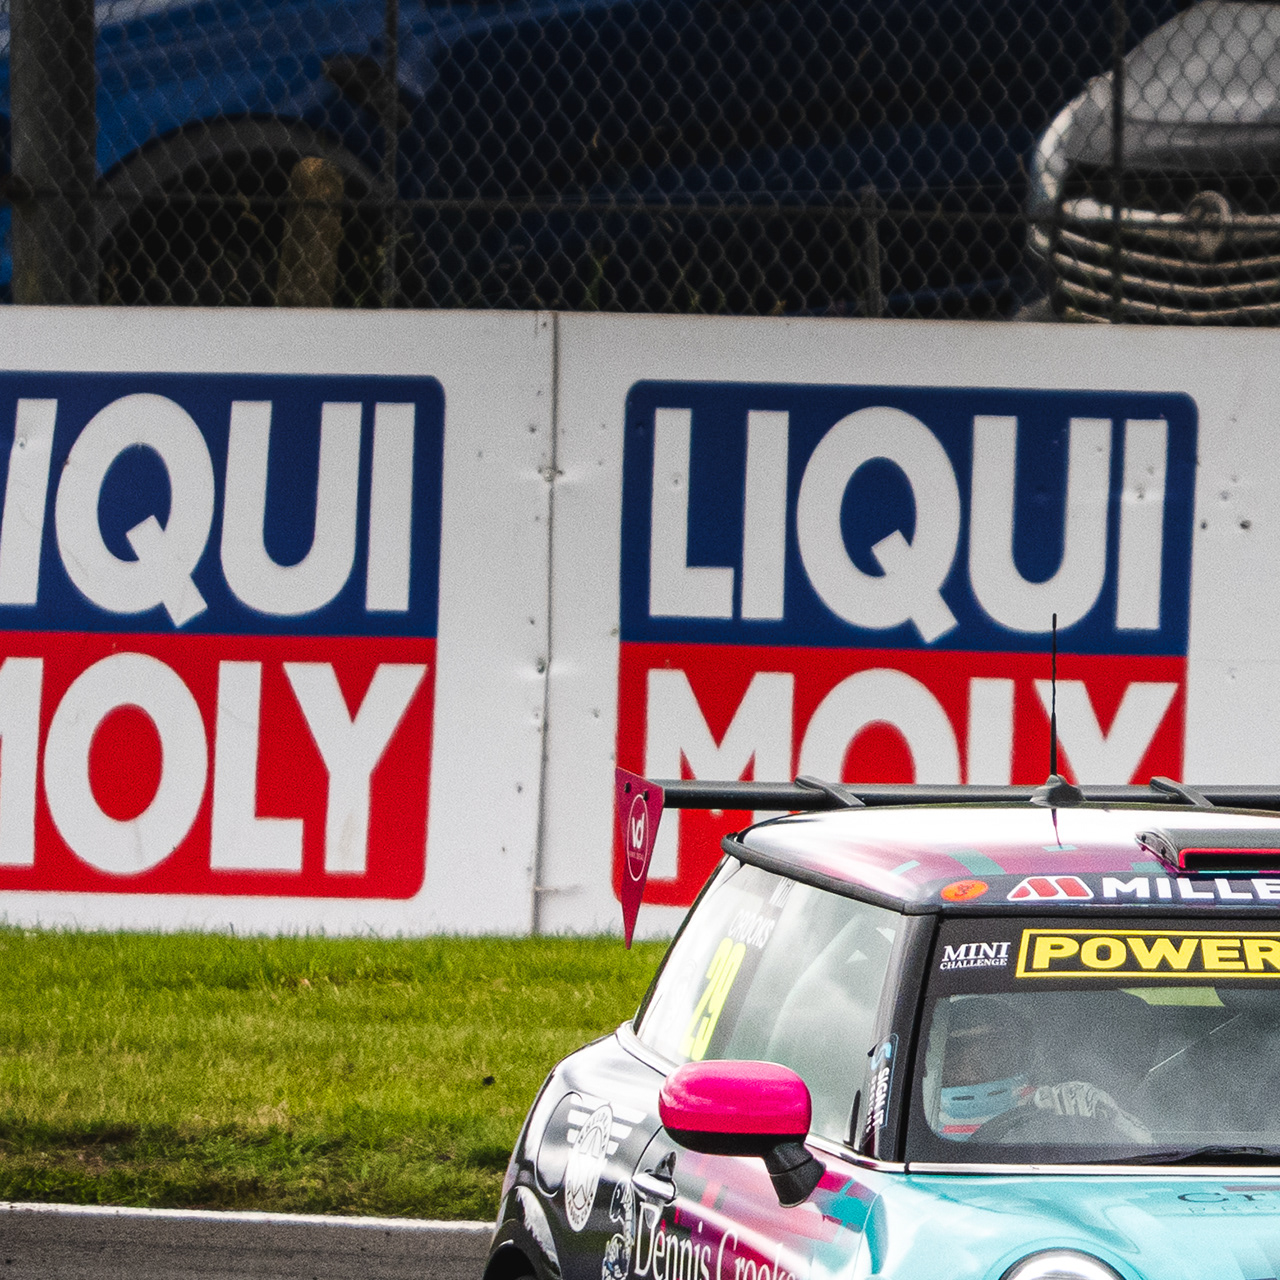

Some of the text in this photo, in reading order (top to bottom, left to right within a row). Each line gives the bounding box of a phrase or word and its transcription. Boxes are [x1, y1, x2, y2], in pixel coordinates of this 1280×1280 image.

[648, 407, 1168, 643] LIQUI
[940, 958, 1008, 970] CHALLENGE
[942, 941, 1011, 962] MINI
[677, 937, 747, 1062] 29
